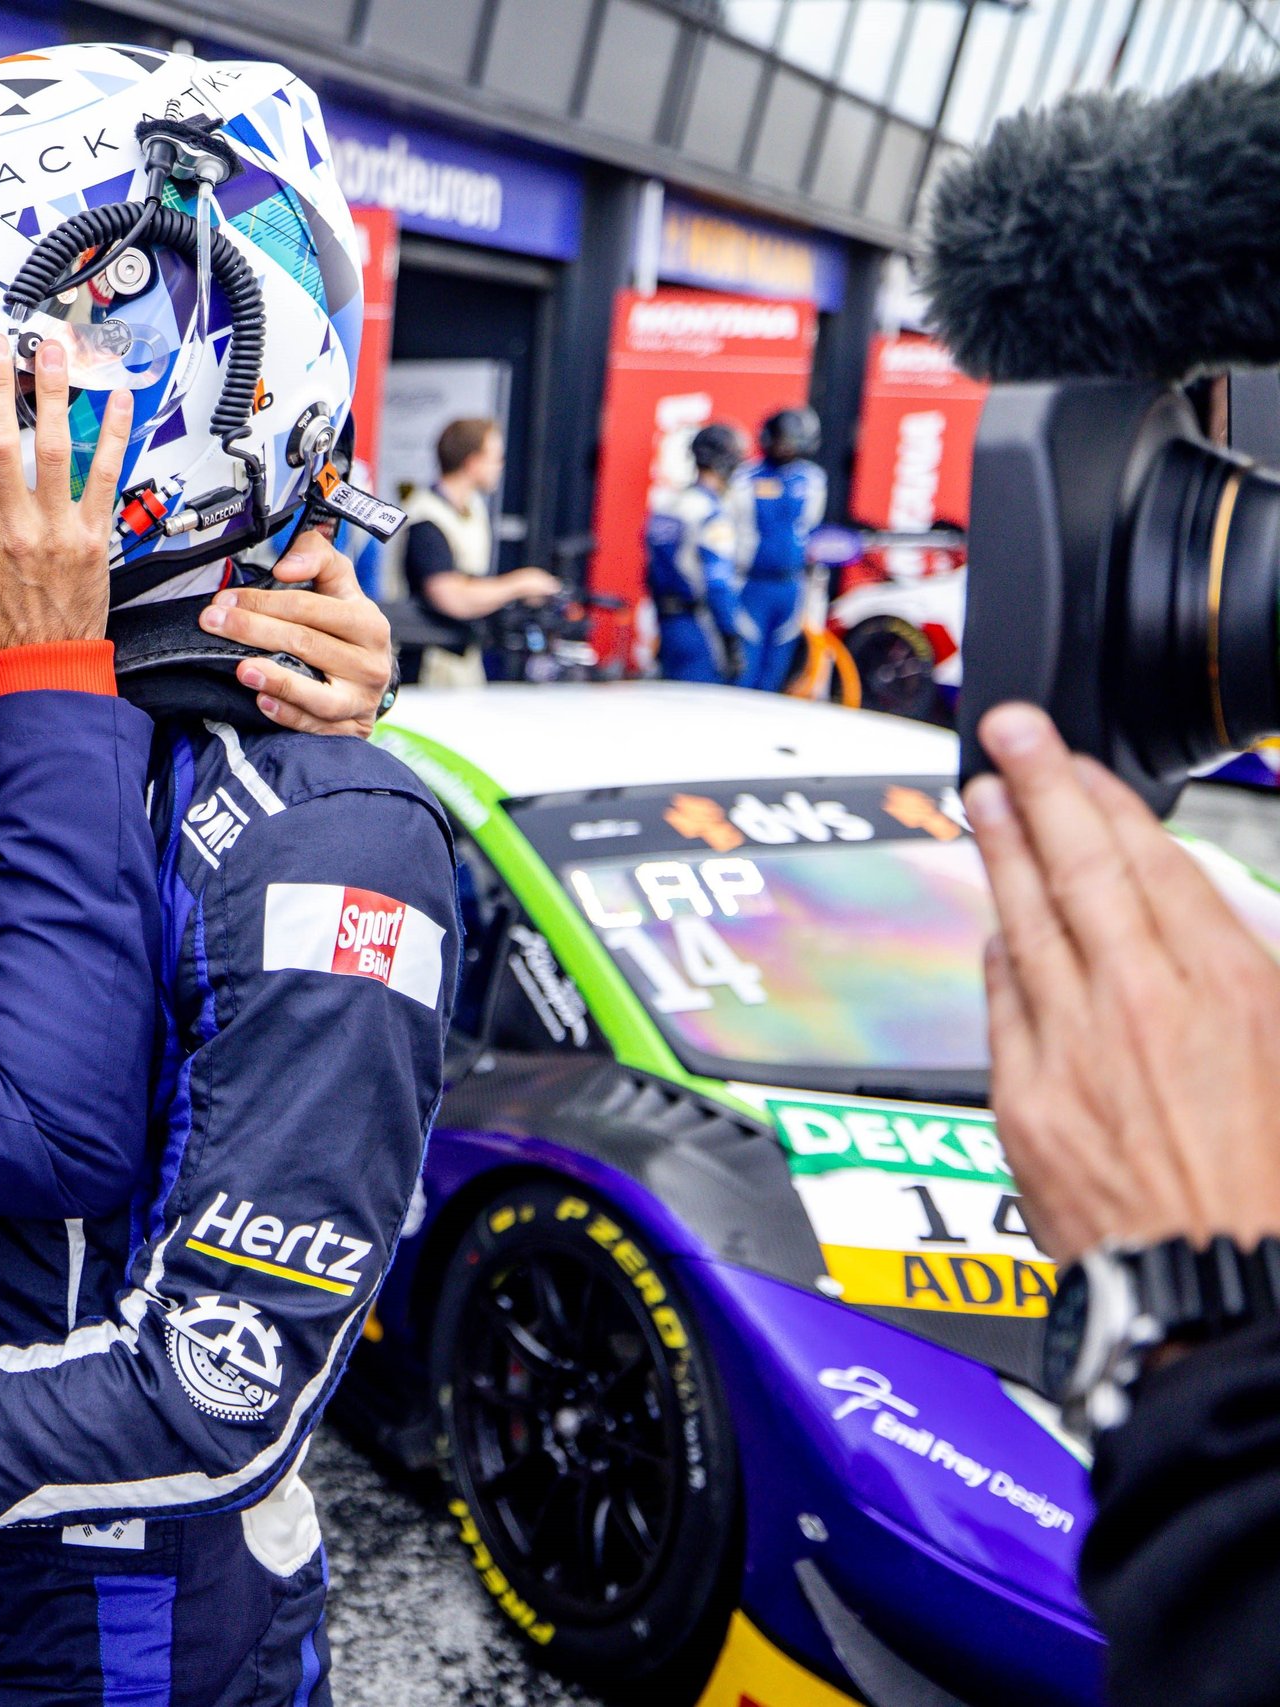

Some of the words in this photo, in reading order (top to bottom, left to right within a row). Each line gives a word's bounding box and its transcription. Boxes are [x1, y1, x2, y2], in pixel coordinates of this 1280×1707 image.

[204, 500, 244, 527] RACECOM
[378, 511, 398, 525] 2019
[187, 795, 244, 856] OMP
[570, 856, 766, 929] LAP
[338, 904, 403, 953] Sport
[358, 947, 391, 980] Bild
[606, 914, 768, 1013] 14
[191, 1191, 373, 1284] Hertz
[585, 1212, 689, 1349] ZERO
[872, 1410, 936, 1457] Emil
[928, 1438, 992, 1488] Frey
[988, 1470, 1075, 1534] Design
